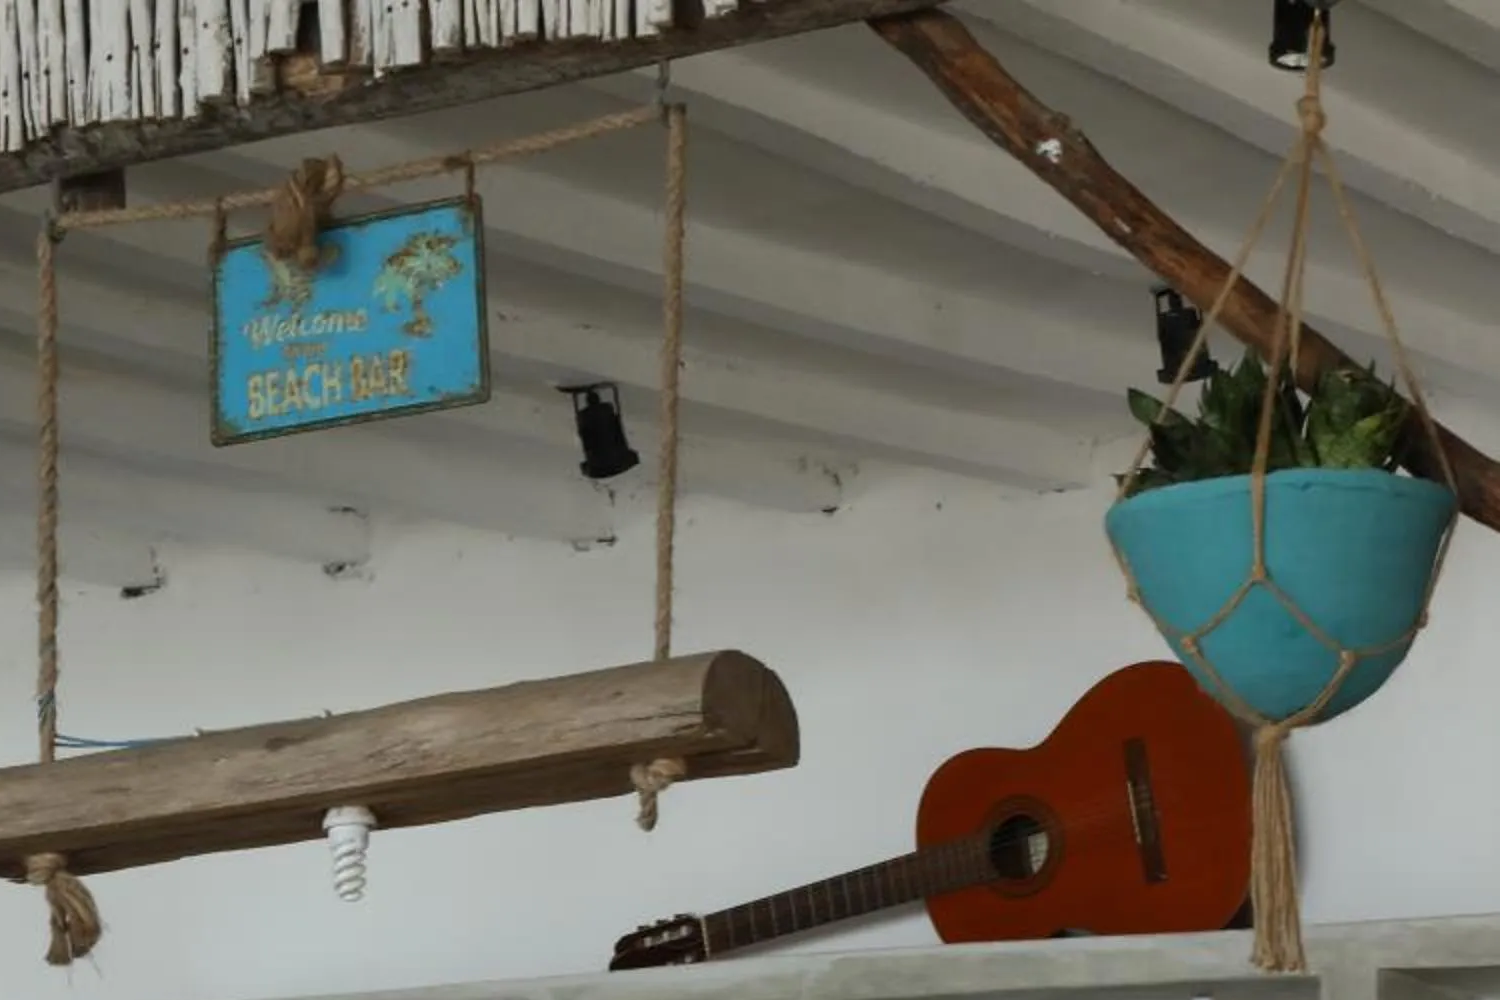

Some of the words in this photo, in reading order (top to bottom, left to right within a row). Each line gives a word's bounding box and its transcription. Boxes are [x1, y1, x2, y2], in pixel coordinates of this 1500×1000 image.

[243, 309, 368, 349] Welcome
[248, 361, 343, 418] BEACH
[352, 349, 409, 400] BAR
